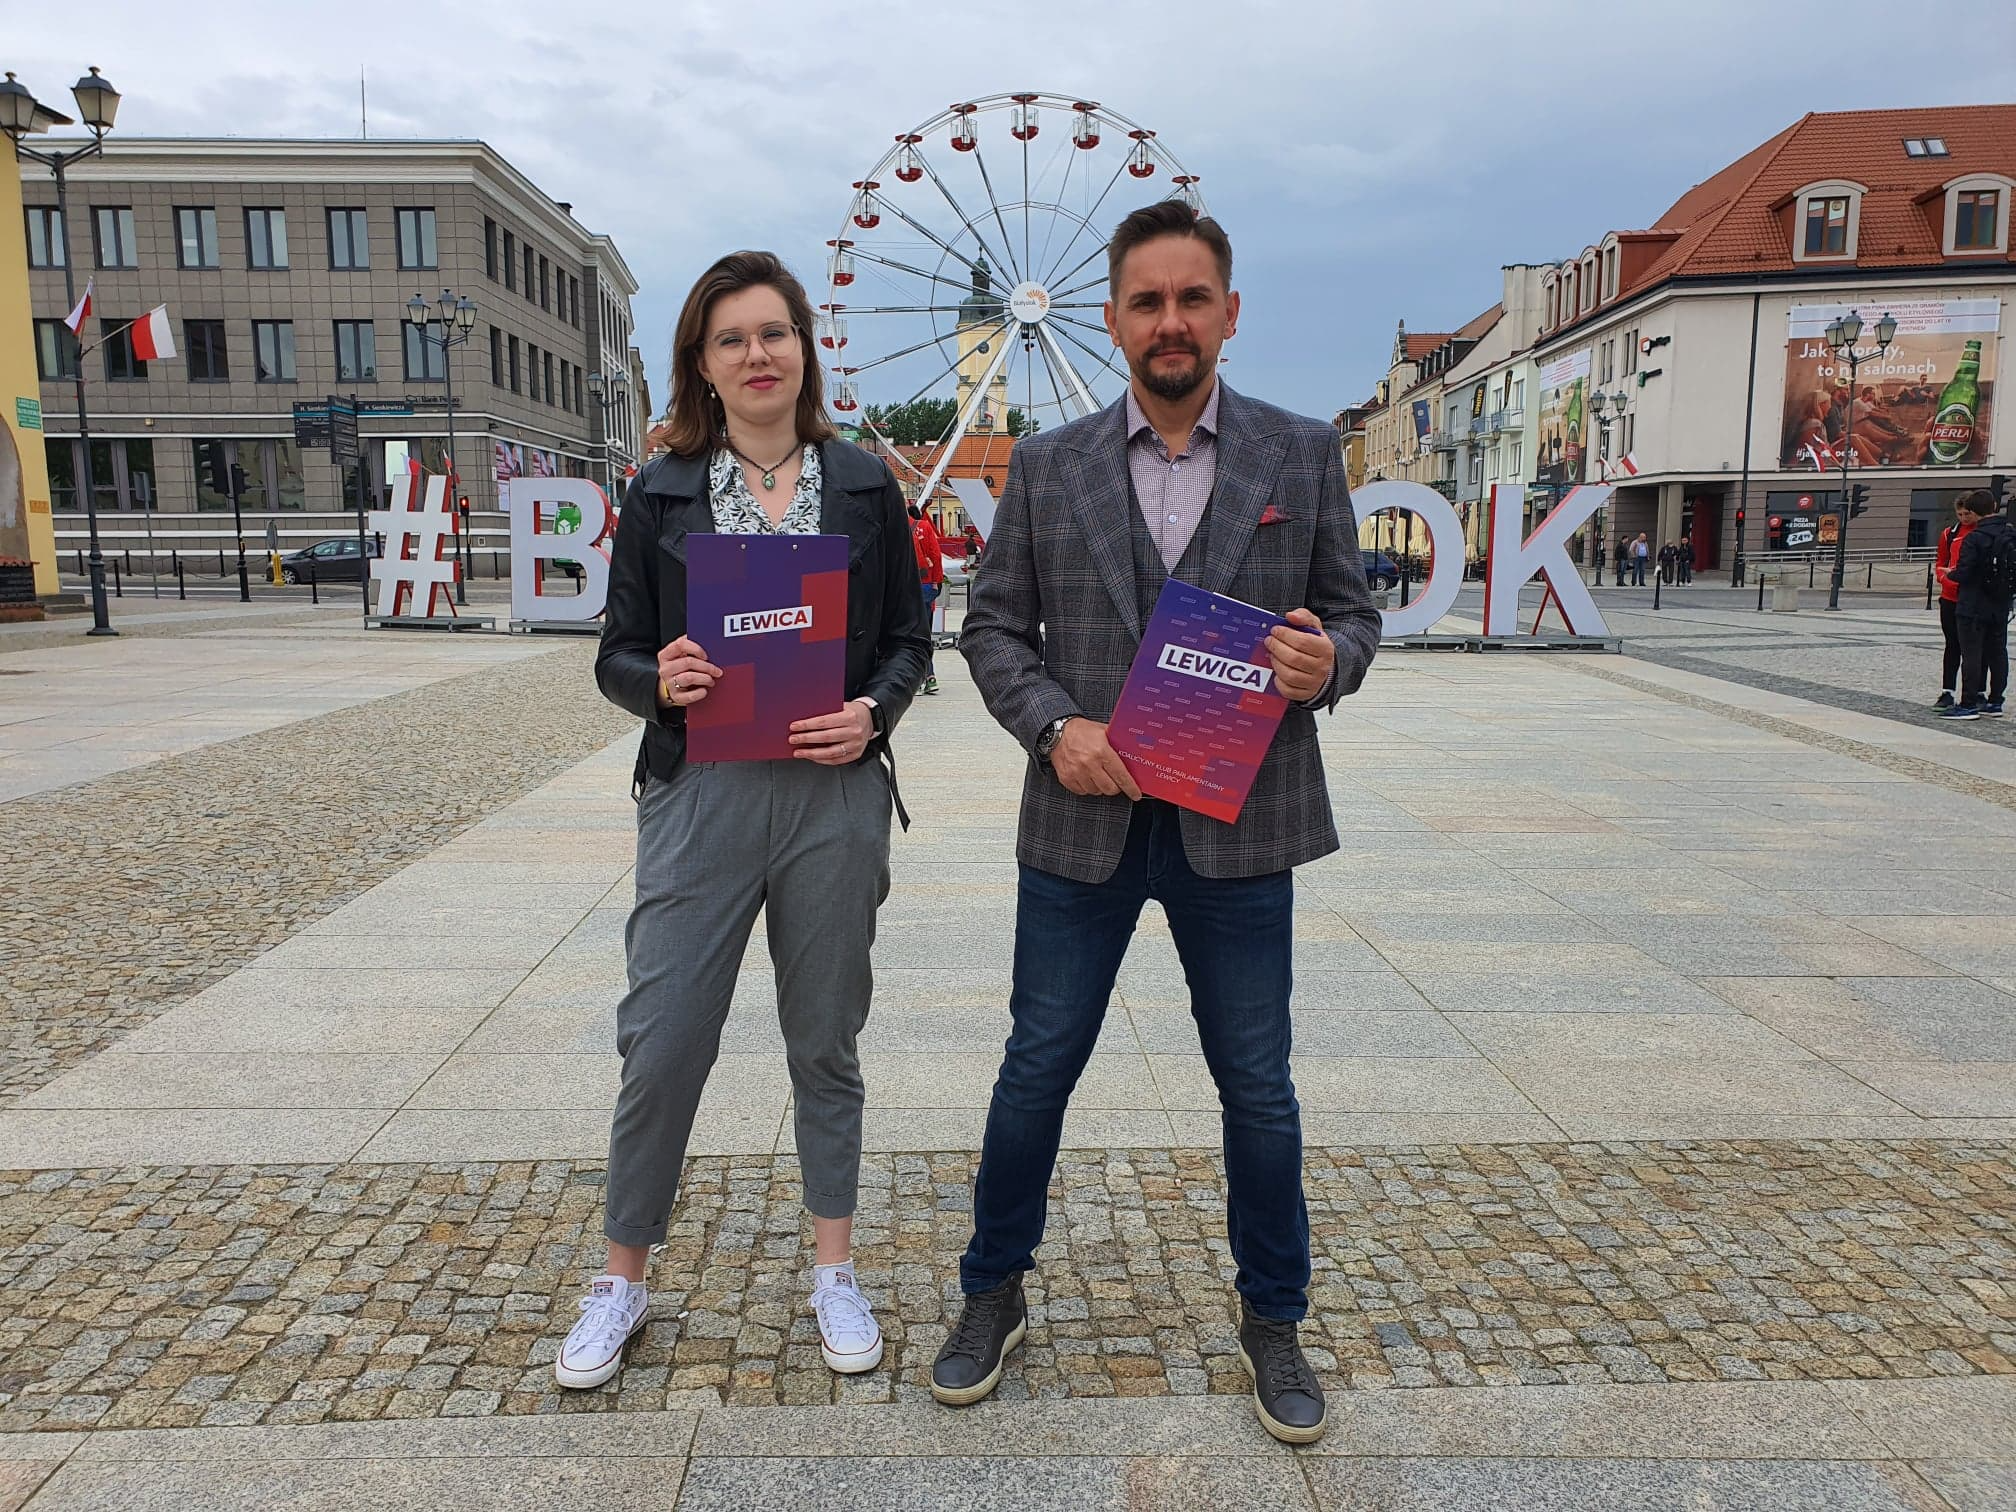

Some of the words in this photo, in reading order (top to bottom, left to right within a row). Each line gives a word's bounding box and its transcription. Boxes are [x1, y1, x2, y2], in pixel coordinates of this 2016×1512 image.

[1799, 342, 1828, 359] Jak
[1817, 364, 1834, 377] to
[1863, 358, 1937, 376] salonach
[729, 610, 808, 633] LEWICA
[1165, 649, 1261, 687] LEWICA
[1155, 771, 1181, 784] LEWICY
[1155, 763, 1172, 774] KLUB
[1172, 768, 1224, 793] PARLAMENTARNY
